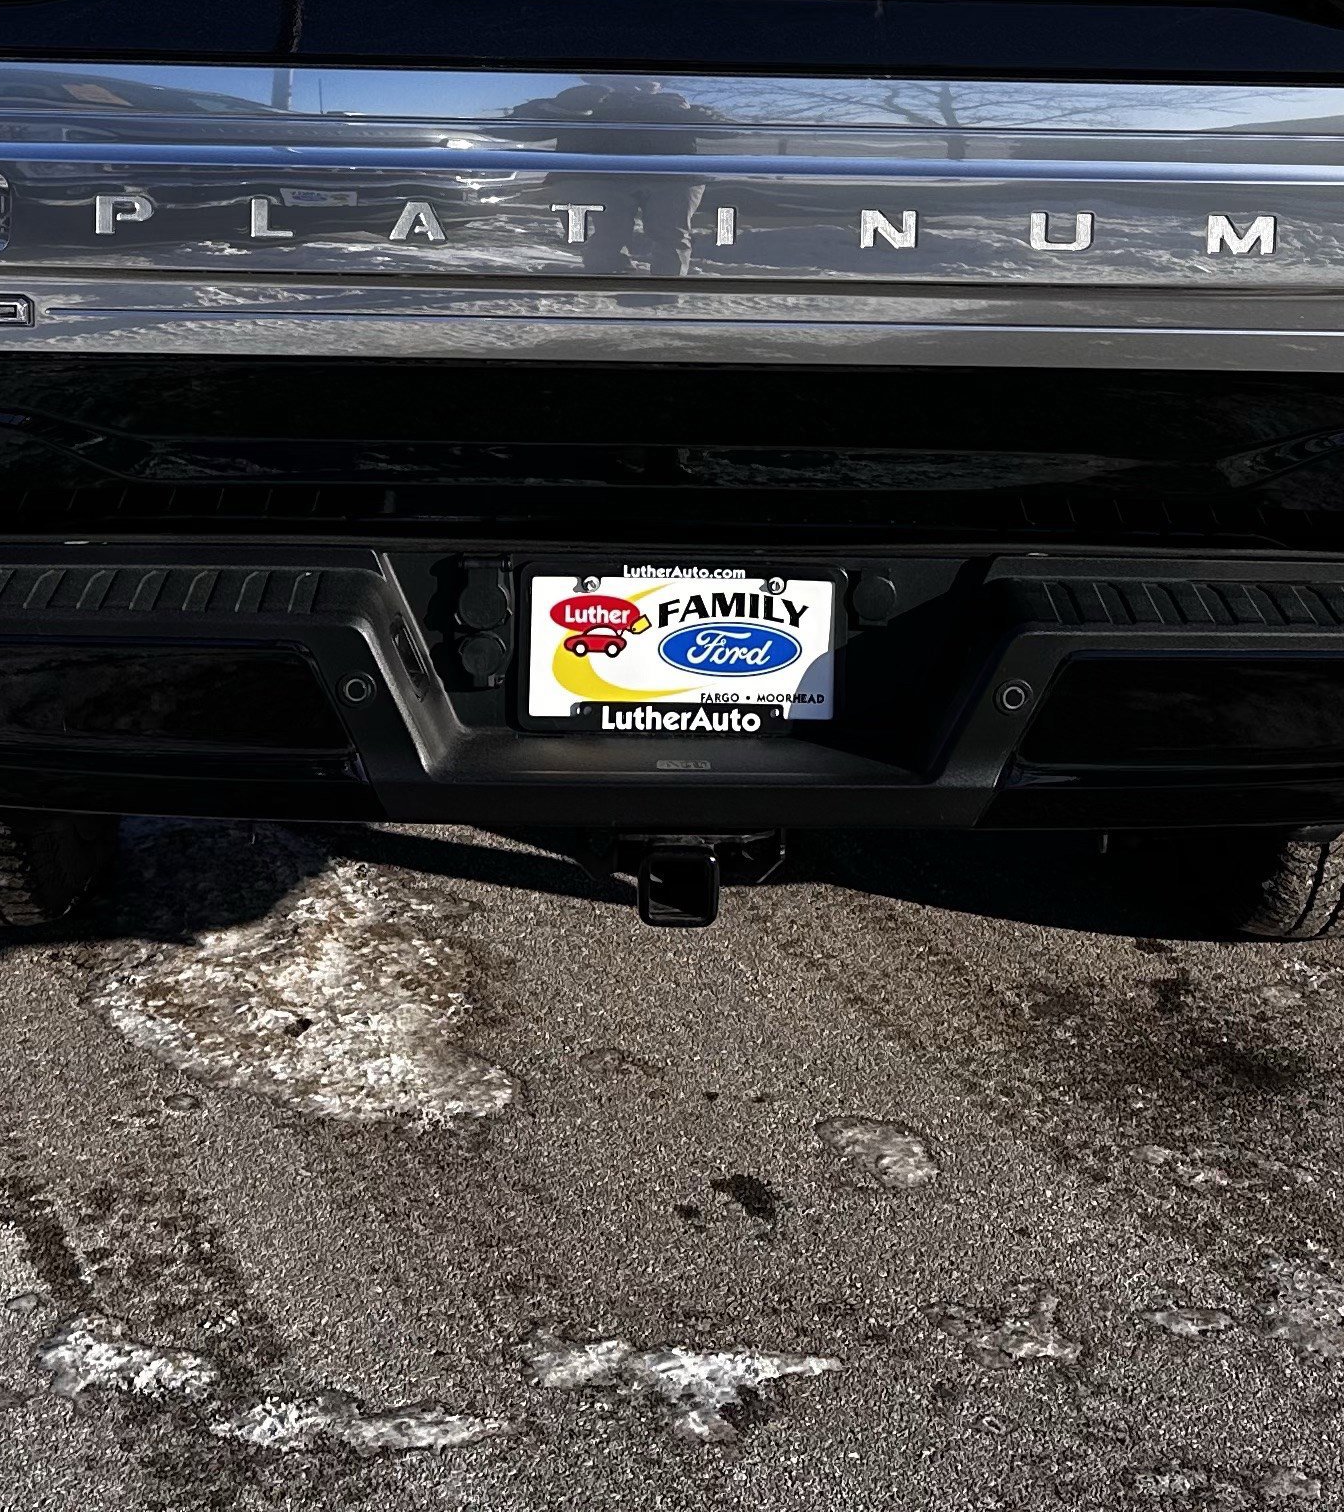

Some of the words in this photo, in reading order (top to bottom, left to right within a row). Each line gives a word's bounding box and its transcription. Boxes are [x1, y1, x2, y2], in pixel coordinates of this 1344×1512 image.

[94, 193, 1278, 256] PLATINUM
[623, 564, 746, 579] LutherAuto.com
[564, 604, 631, 624] Luther
[658, 591, 810, 629] FAMILY
[686, 629, 773, 666] Ford
[700, 692, 739, 704] FARGO
[756, 692, 825, 704] MOORHEAD
[601, 705, 761, 732] LutherAuto
